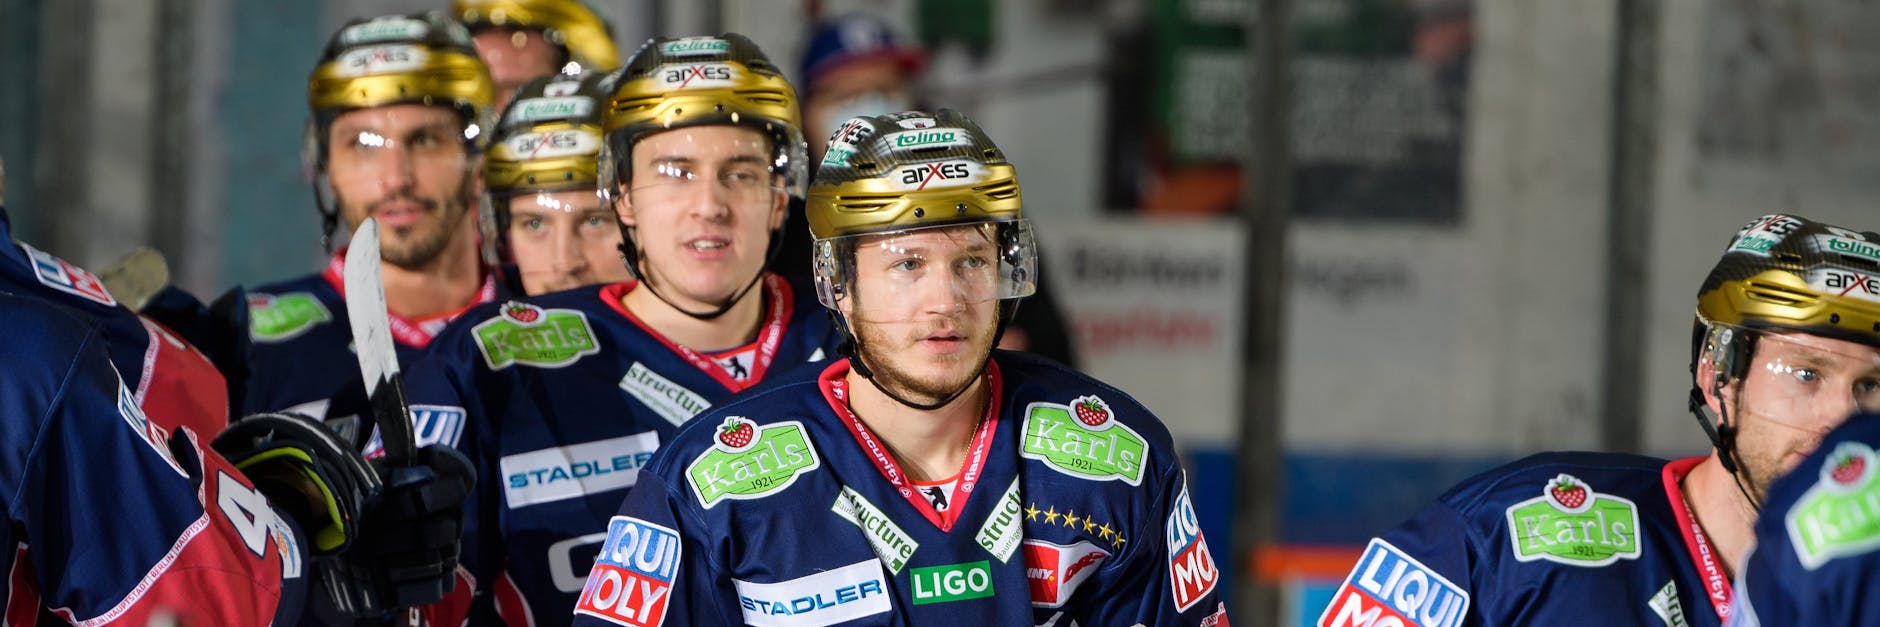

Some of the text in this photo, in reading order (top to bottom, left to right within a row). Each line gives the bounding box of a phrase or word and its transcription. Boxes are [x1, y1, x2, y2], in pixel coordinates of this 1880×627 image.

[484, 320, 587, 358] Karls
[627, 367, 703, 416] structur
[1031, 417, 1135, 473] Karls
[1071, 457, 1093, 471] 1921
[699, 440, 805, 496] Karls
[751, 475, 774, 490] 1921
[174, 513, 209, 551] HAUPTSTAD
[1170, 495, 1200, 557] LIQ
[1520, 509, 1629, 550] Karls
[914, 567, 989, 599] LIGO
[1174, 540, 1213, 604] MO
[1358, 546, 1465, 627] LIQUI
[740, 579, 882, 616] STADLER
